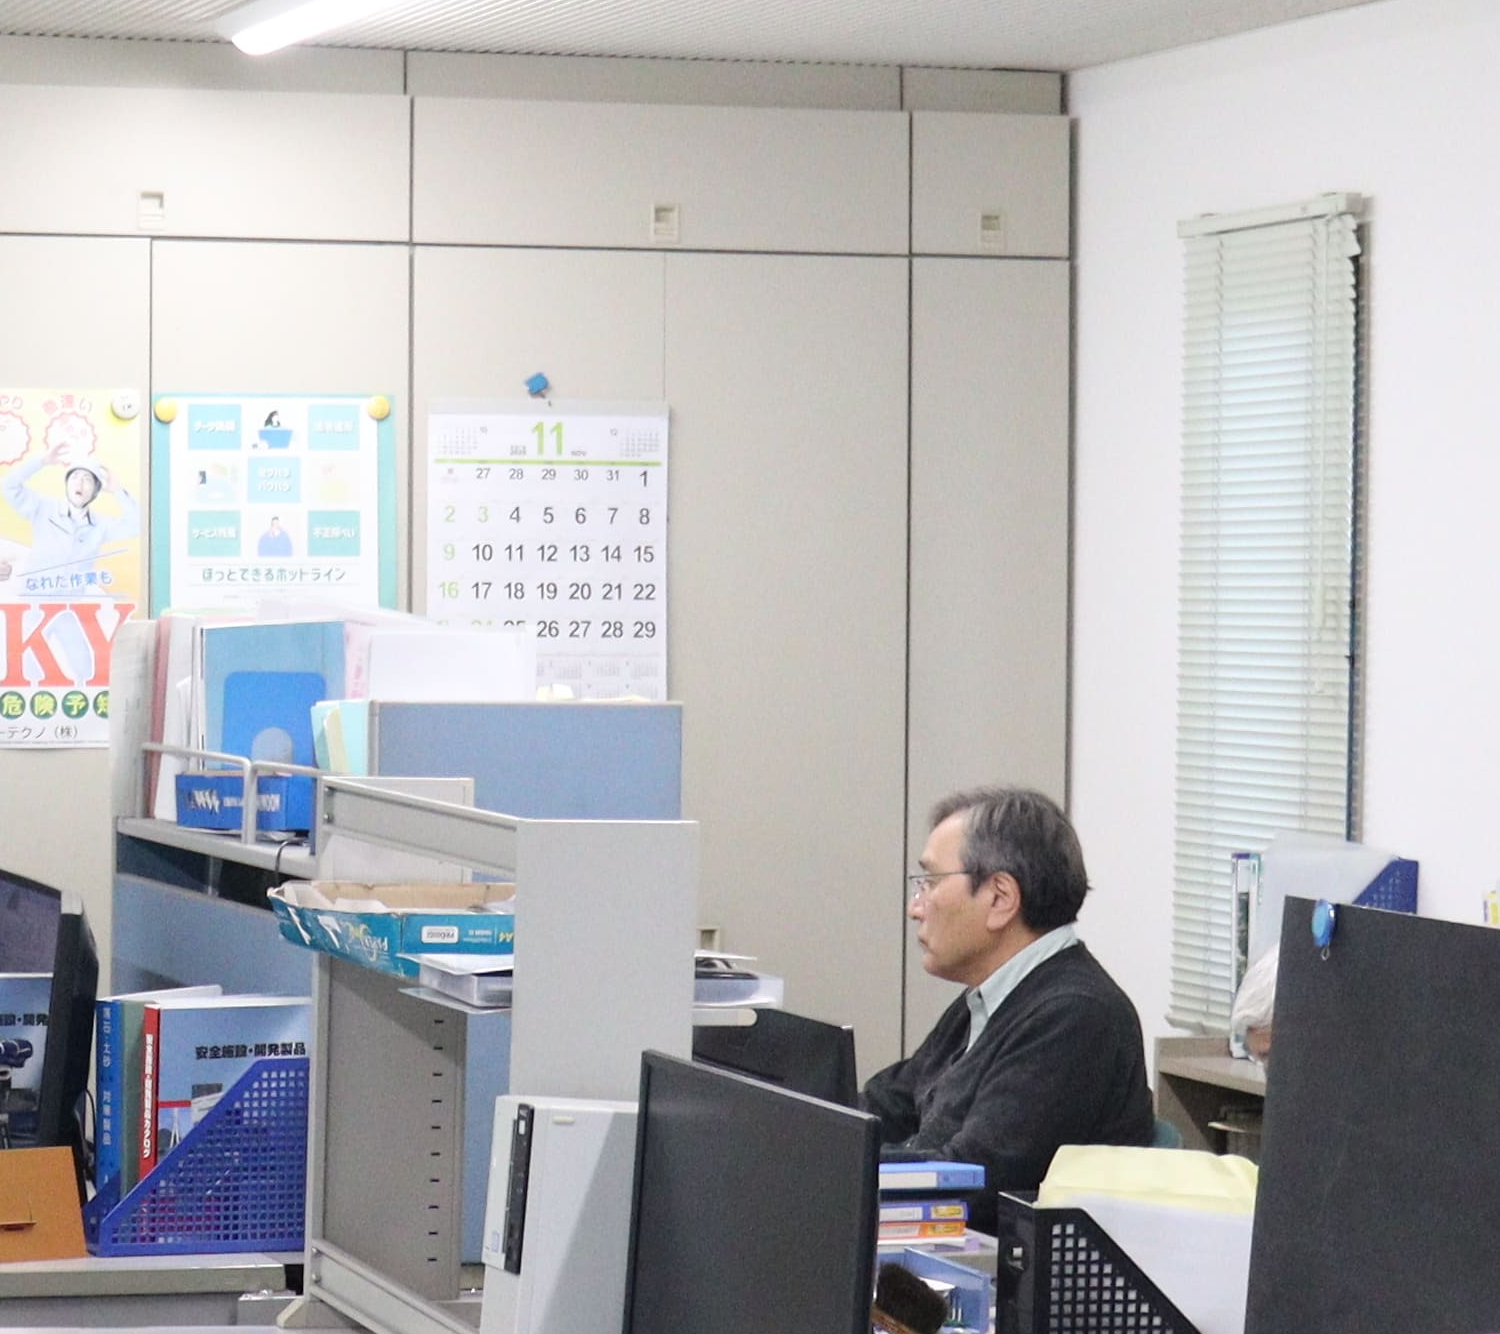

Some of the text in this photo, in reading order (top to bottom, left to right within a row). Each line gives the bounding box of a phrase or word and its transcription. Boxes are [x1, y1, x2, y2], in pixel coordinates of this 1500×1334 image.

[531, 421, 564, 456] 11
[475, 466, 649, 487] 27 28 29 30 31 1
[443, 504, 651, 526] 2 3 4 5 6 7 8
[442, 542, 655, 563] 9 10 11 12 13 14 15
[25, 570, 112, 591] なれた作業も
[439, 580, 656, 601] 16 17 18 19 20 21 22
[536, 619, 657, 639] 26 27 28 29
